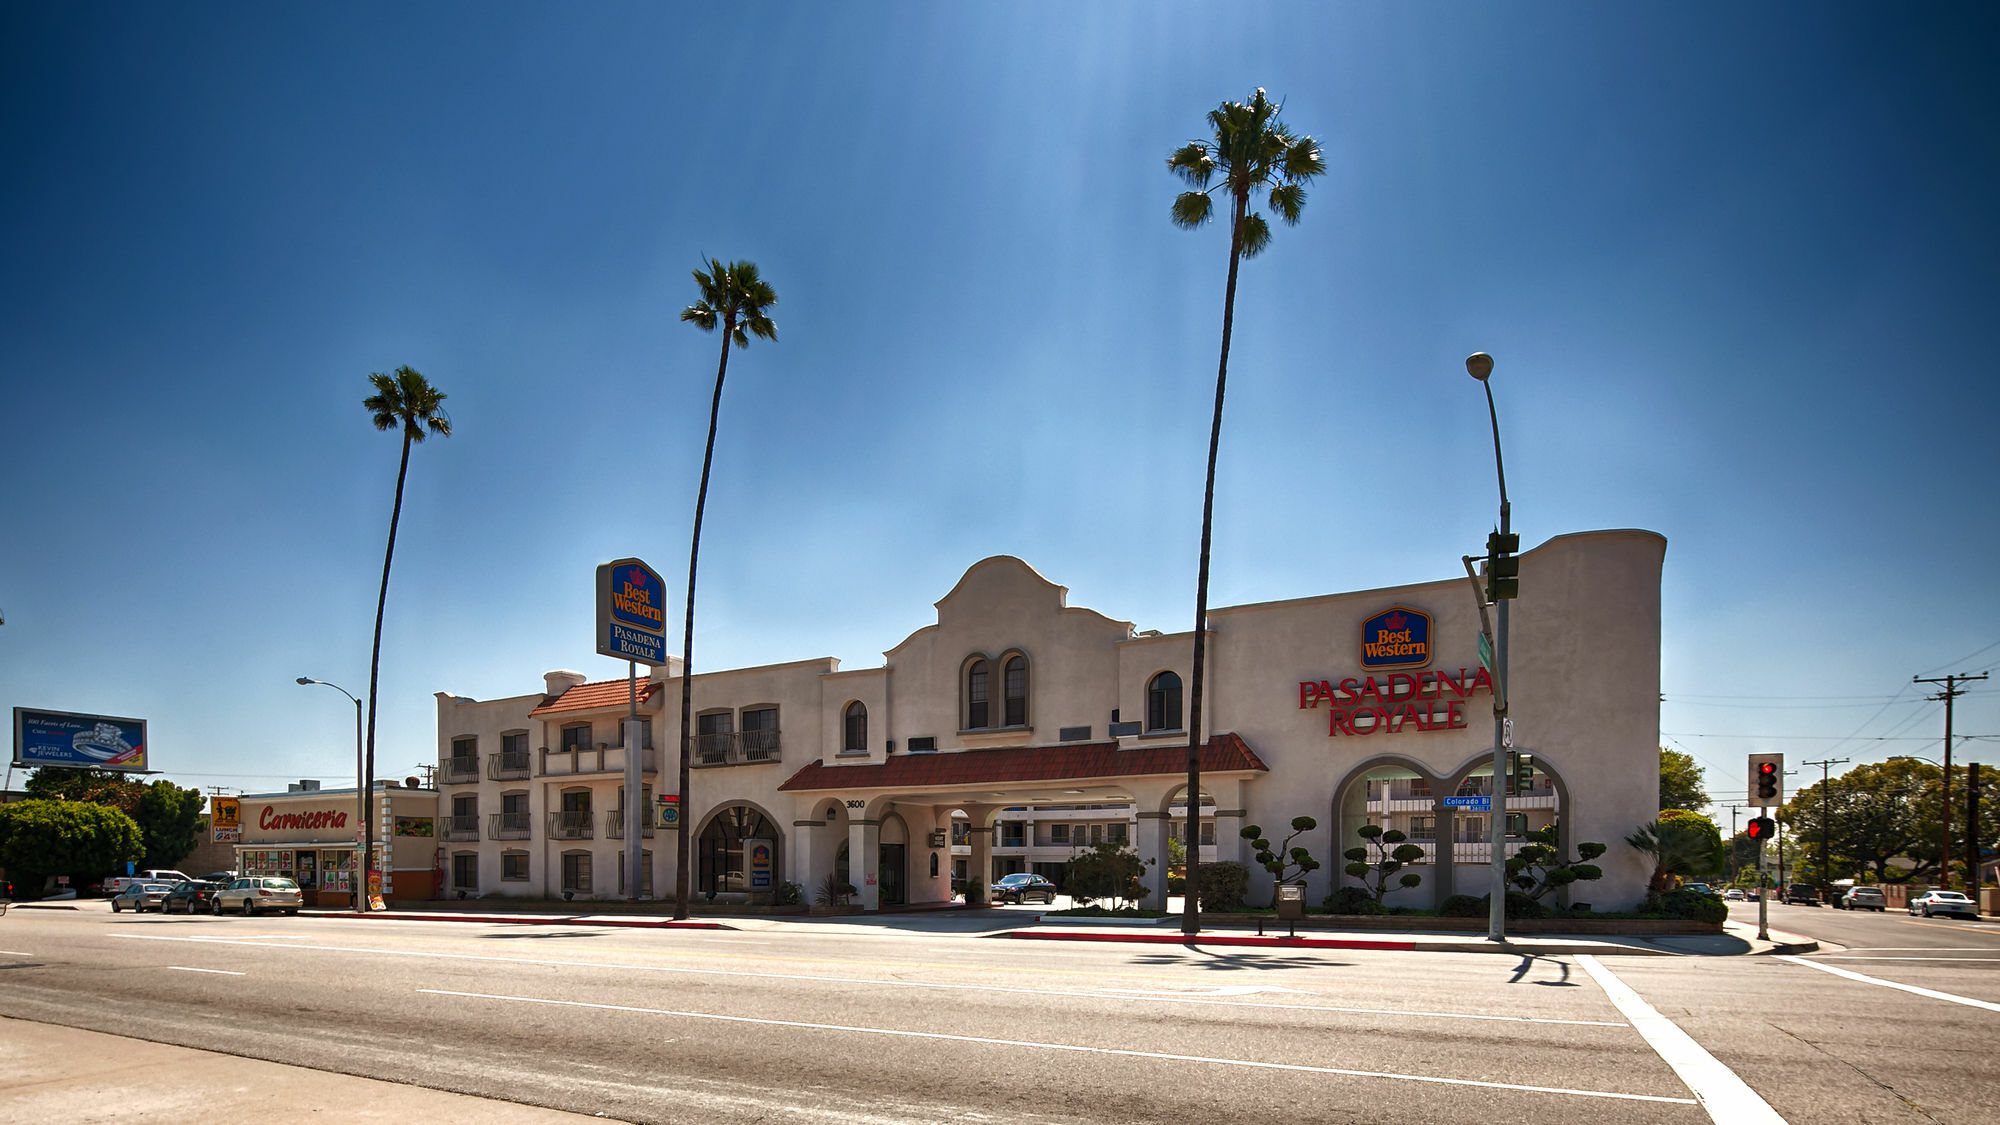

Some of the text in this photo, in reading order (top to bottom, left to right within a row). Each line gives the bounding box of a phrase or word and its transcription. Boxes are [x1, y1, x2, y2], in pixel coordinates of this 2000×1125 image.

[624, 581, 650, 604] Best
[613, 592, 661, 621] Western
[614, 625, 661, 648] PASADENA
[1377, 628, 1412, 645] Best
[621, 640, 656, 659] ROYALE
[1364, 641, 1426, 658] Western
[1299, 667, 1494, 709] PASADENA
[1328, 701, 1468, 737] ROYALE
[37, 750, 73, 758] JEWELERS
[846, 799, 865, 809] 3600
[259, 805, 348, 831] Carniceria
